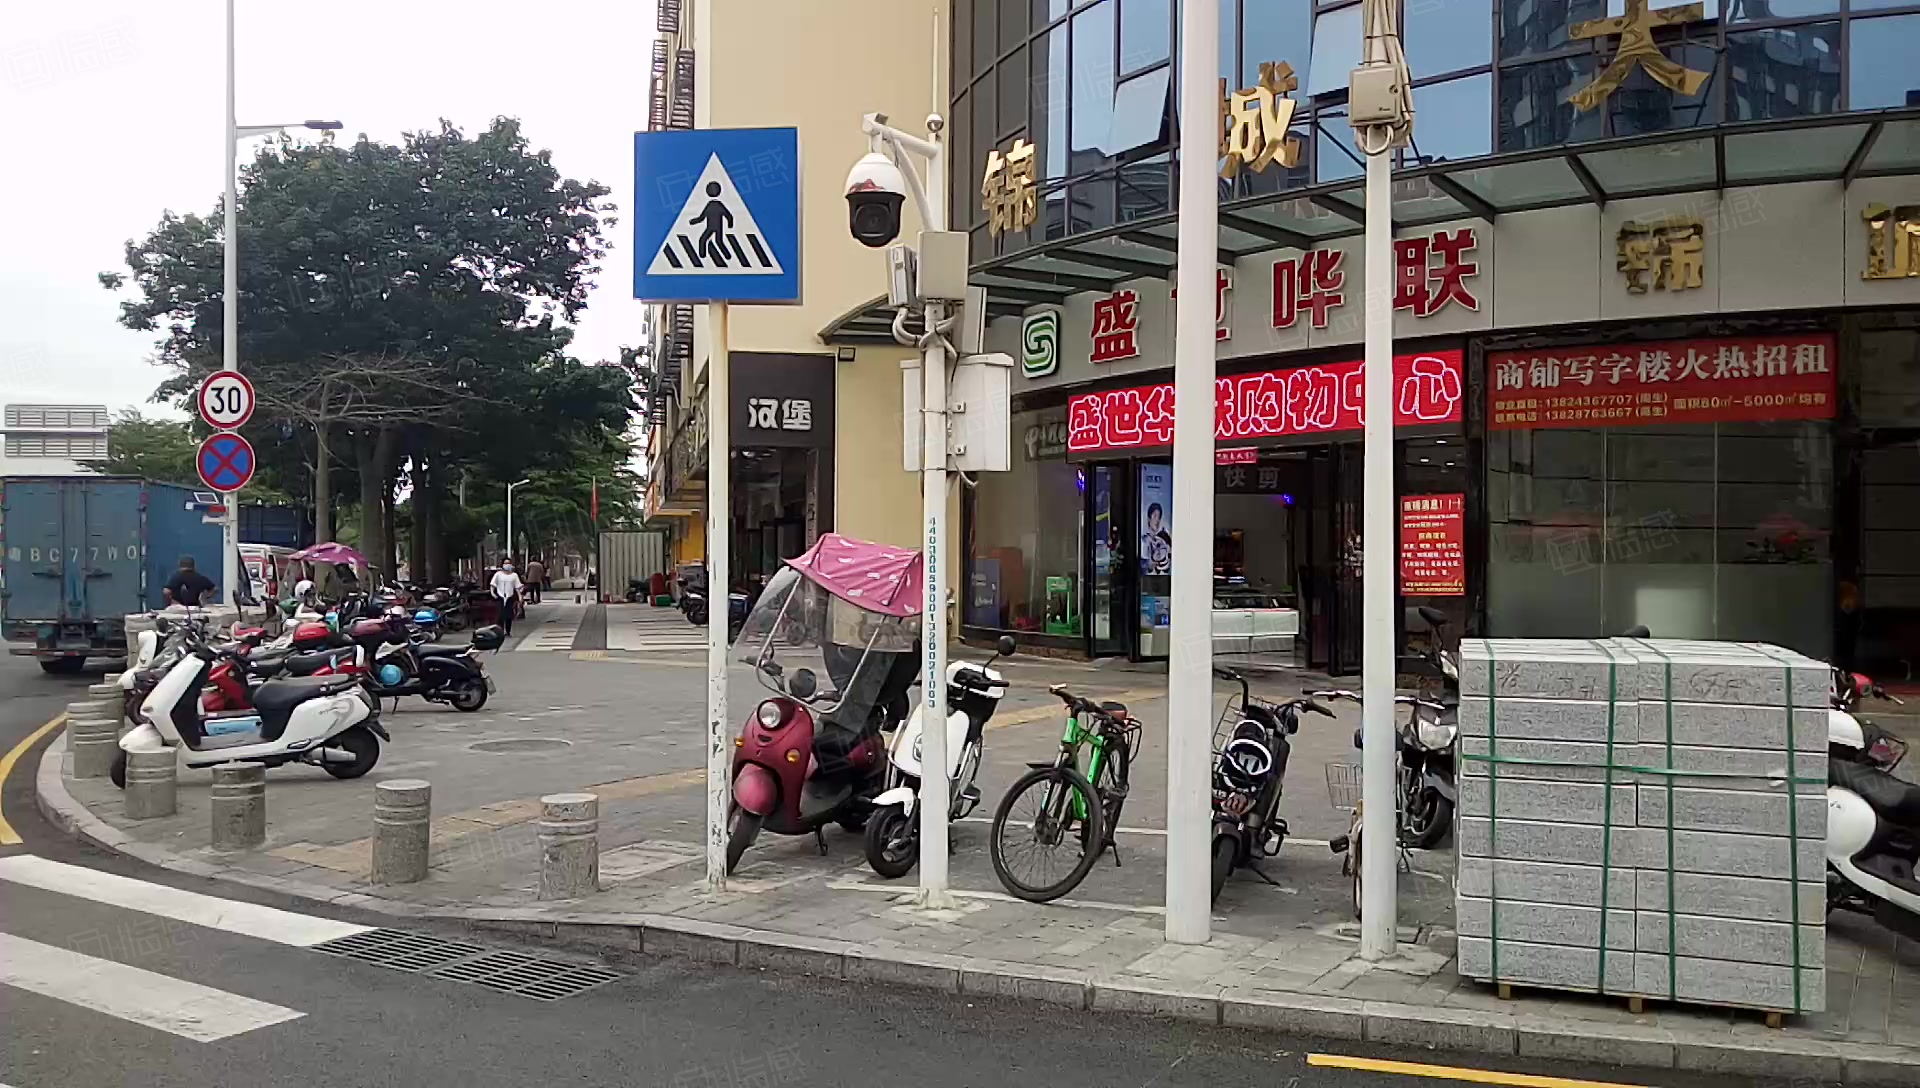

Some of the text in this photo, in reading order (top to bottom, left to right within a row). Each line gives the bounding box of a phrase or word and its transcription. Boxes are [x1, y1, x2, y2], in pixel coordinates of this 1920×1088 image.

[1495, 344, 1830, 391] 商铺写字楼火热招租
[210, 386, 241, 414] 30
[747, 398, 812, 430] 汉堡
